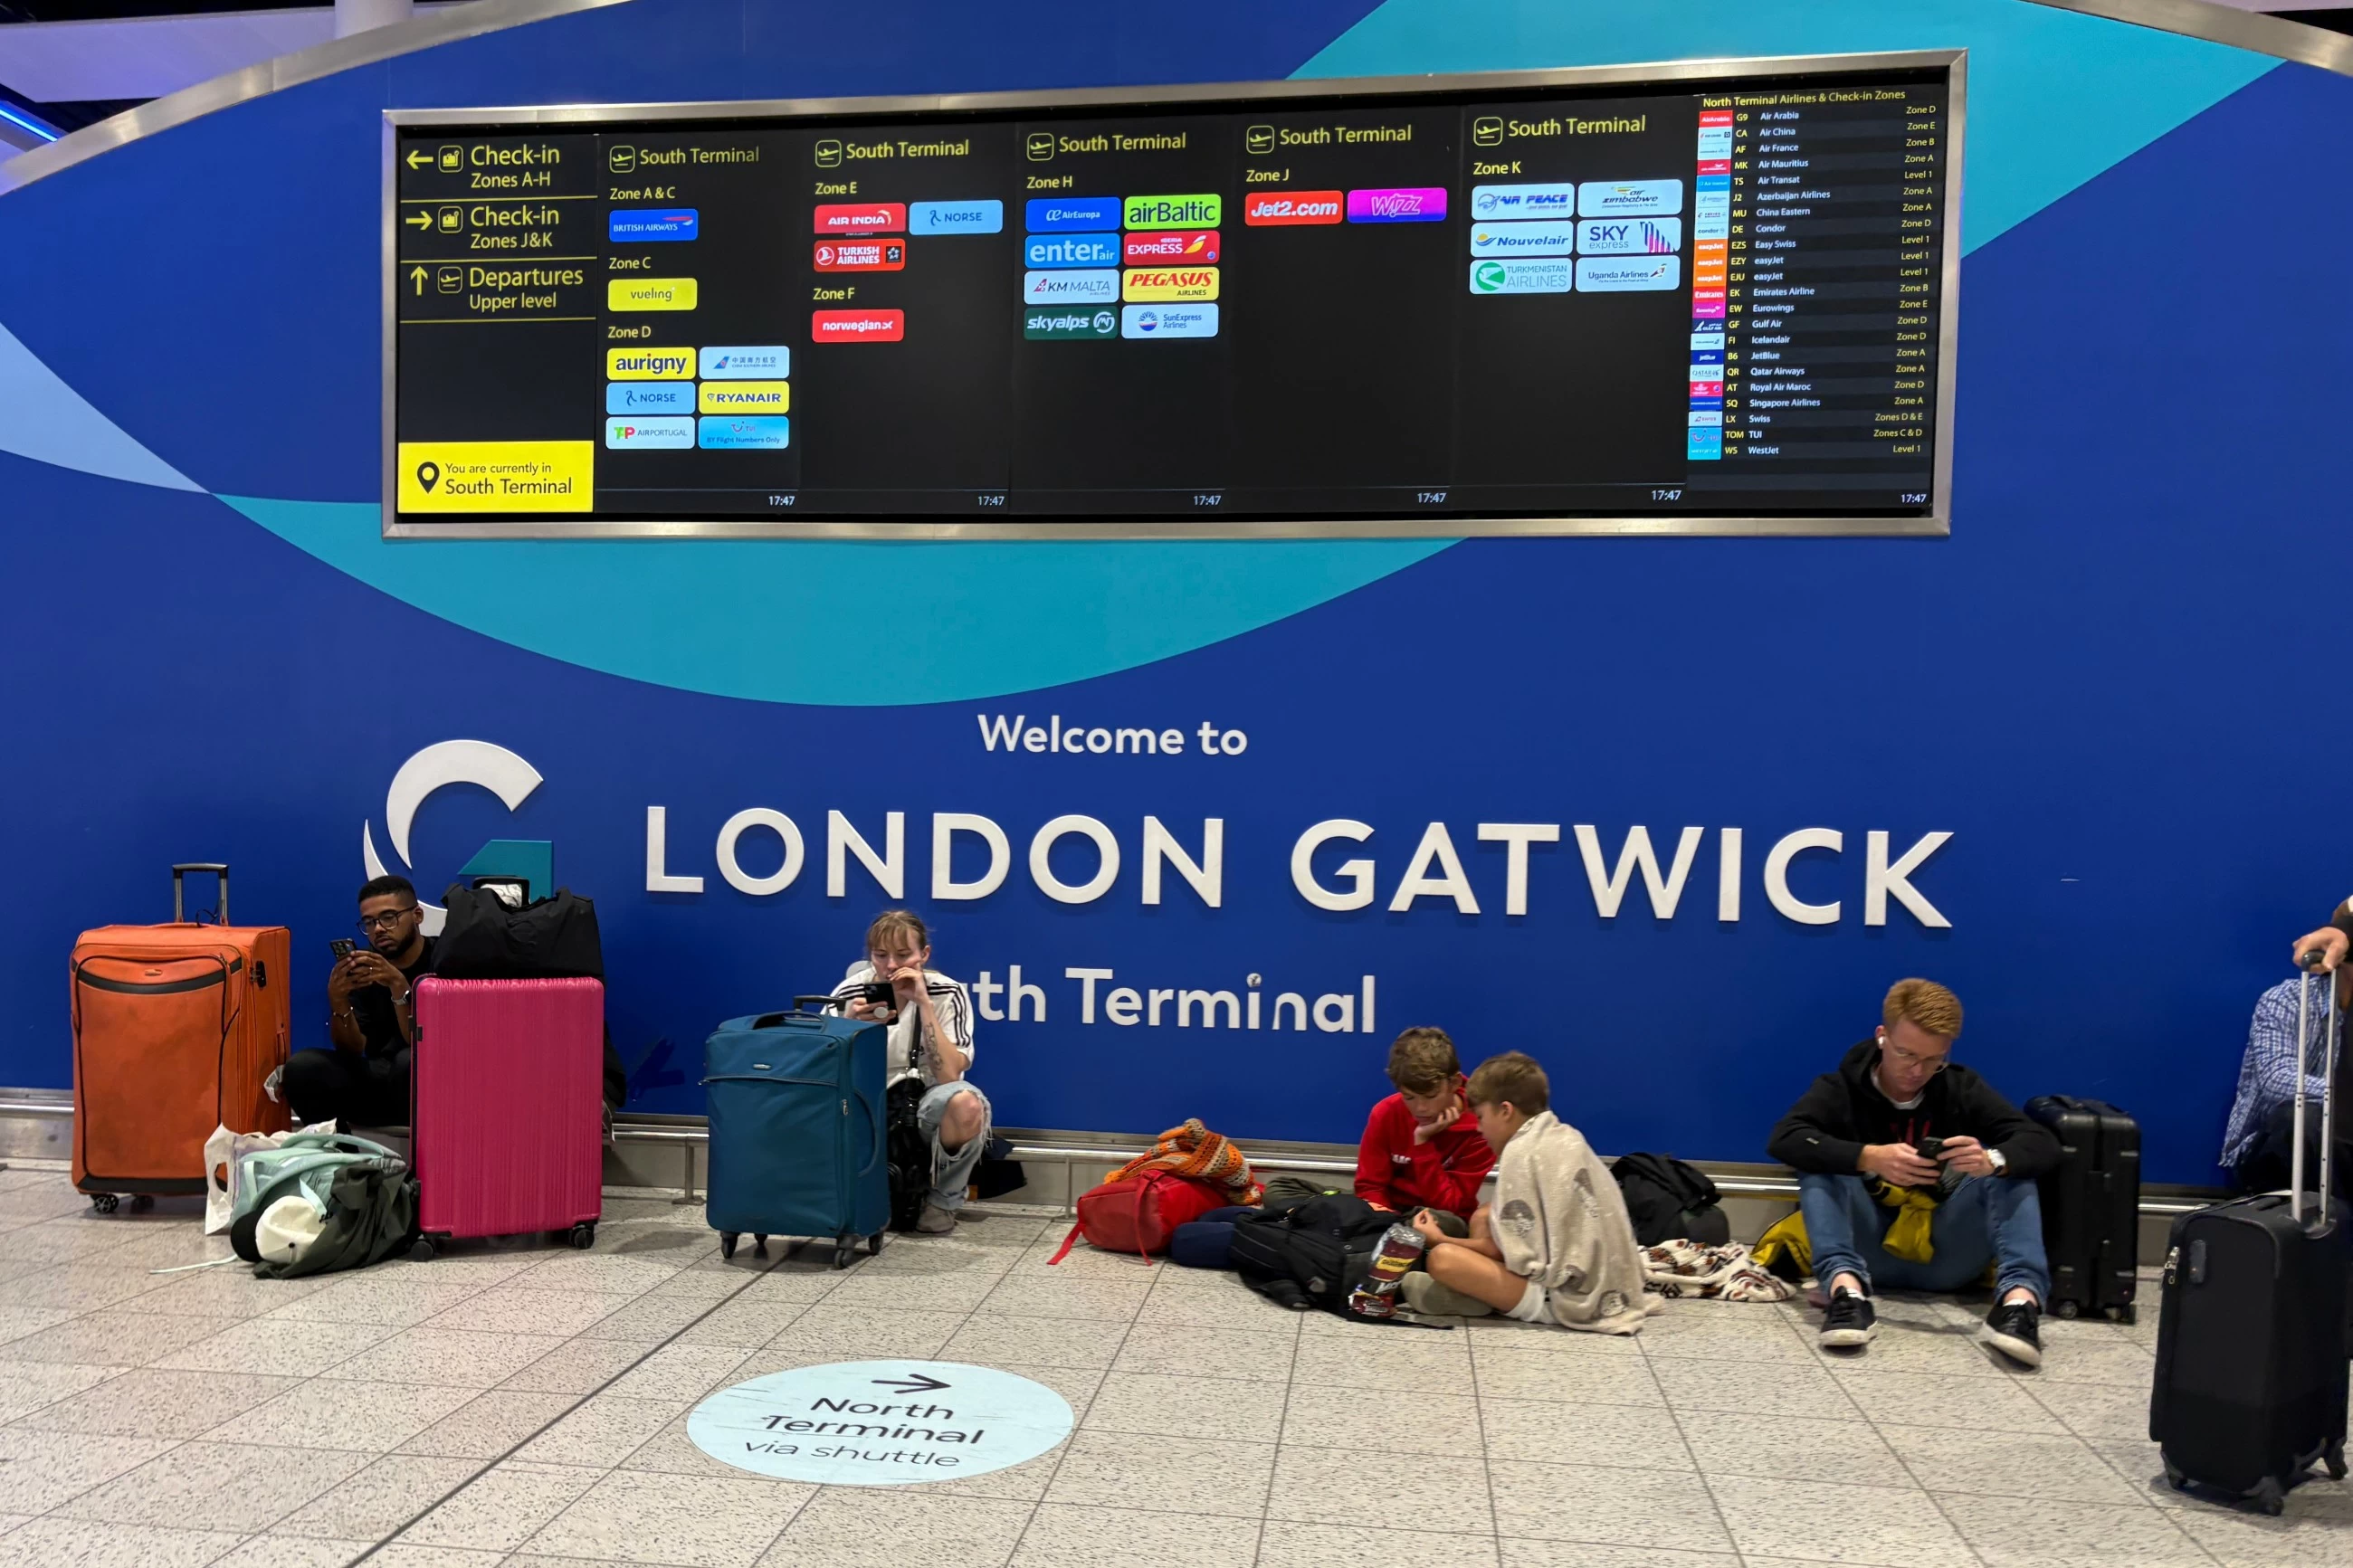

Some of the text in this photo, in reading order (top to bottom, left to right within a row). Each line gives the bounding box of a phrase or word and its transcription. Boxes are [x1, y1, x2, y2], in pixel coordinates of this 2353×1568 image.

[1703, 90, 1905, 107] North Terminal Airlines & Check-in Zones
[1774, 111, 1799, 119] Arabia
[1509, 115, 1645, 137] South Terminal
[1281, 125, 1411, 145] South Terminal
[1060, 132, 1186, 152] South Terminal
[847, 139, 968, 158] South Terminal
[472, 144, 559, 166] Check-in
[641, 147, 758, 164] South Terminal
[1473, 161, 1520, 175] Zone K
[1772, 159, 1808, 167] Mauritius
[472, 171, 550, 187] Zones A-H
[1246, 169, 1289, 182] Zone J
[1027, 176, 1072, 188] Zone H
[610, 186, 675, 199] Zone A & C
[815, 182, 856, 195] Zone E
[1500, 195, 1567, 204] AIR PEACE
[1129, 202, 1215, 223] airBaltic
[1252, 201, 1338, 217] Jet2.com
[471, 205, 558, 226] Check-in
[852, 216, 885, 224] INDIA
[945, 213, 982, 222] NORSE
[1590, 225, 1628, 241] SKY
[1756, 224, 1786, 233] Condor
[471, 233, 517, 248] Zones
[1498, 236, 1568, 245] Nouvelair
[1589, 242, 1628, 250] express
[1756, 241, 1773, 250] Easy
[1902, 235, 1923, 243] Level
[837, 246, 880, 255] TURKISH
[1128, 243, 1183, 254] EXPRESS
[609, 257, 651, 269] Zone C
[837, 255, 880, 264] AIRLINES
[1507, 265, 1567, 273] TURKMENISTAN
[471, 268, 583, 290] Departures
[1129, 272, 1213, 287] PEGASUS
[1507, 275, 1567, 287] AIRLINES
[1588, 271, 1618, 280] Uganda
[1048, 281, 1110, 291] KM MALTA
[631, 287, 675, 301] vueling
[814, 288, 854, 299] Zone F
[470, 292, 556, 312] Upper level
[1027, 315, 1090, 331] skyalps
[1164, 314, 1202, 322] SunExpress
[1752, 319, 1769, 328] Gulf
[608, 326, 651, 337] Zone D
[822, 320, 881, 332] norwegian
[616, 354, 687, 375] aurigny
[1750, 367, 1772, 375] Qatar
[1774, 367, 1805, 376] Airways
[641, 394, 675, 402] NORSE
[717, 394, 780, 402] RYANAIR
[1750, 399, 1789, 408] Singapore
[445, 463, 465, 473] You
[491, 461, 538, 476] currently
[542, 462, 551, 472] in
[446, 477, 571, 494] South Terminal
[769, 496, 795, 505] 17:47
[978, 496, 1005, 505] 17:47
[1195, 496, 1221, 505] 17:47
[1418, 493, 1446, 502] 17:47
[1653, 490, 1681, 499] 17:47
[1901, 494, 1926, 502] 17:47
[977, 715, 1247, 755] Welcome to
[647, 806, 1954, 927] LONDON GATWICK
[1066, 968, 1375, 1032] Terminal
[811, 1398, 953, 1419] North
[762, 1416, 984, 1443] Terminal
[747, 1441, 959, 1466] via shuttle
